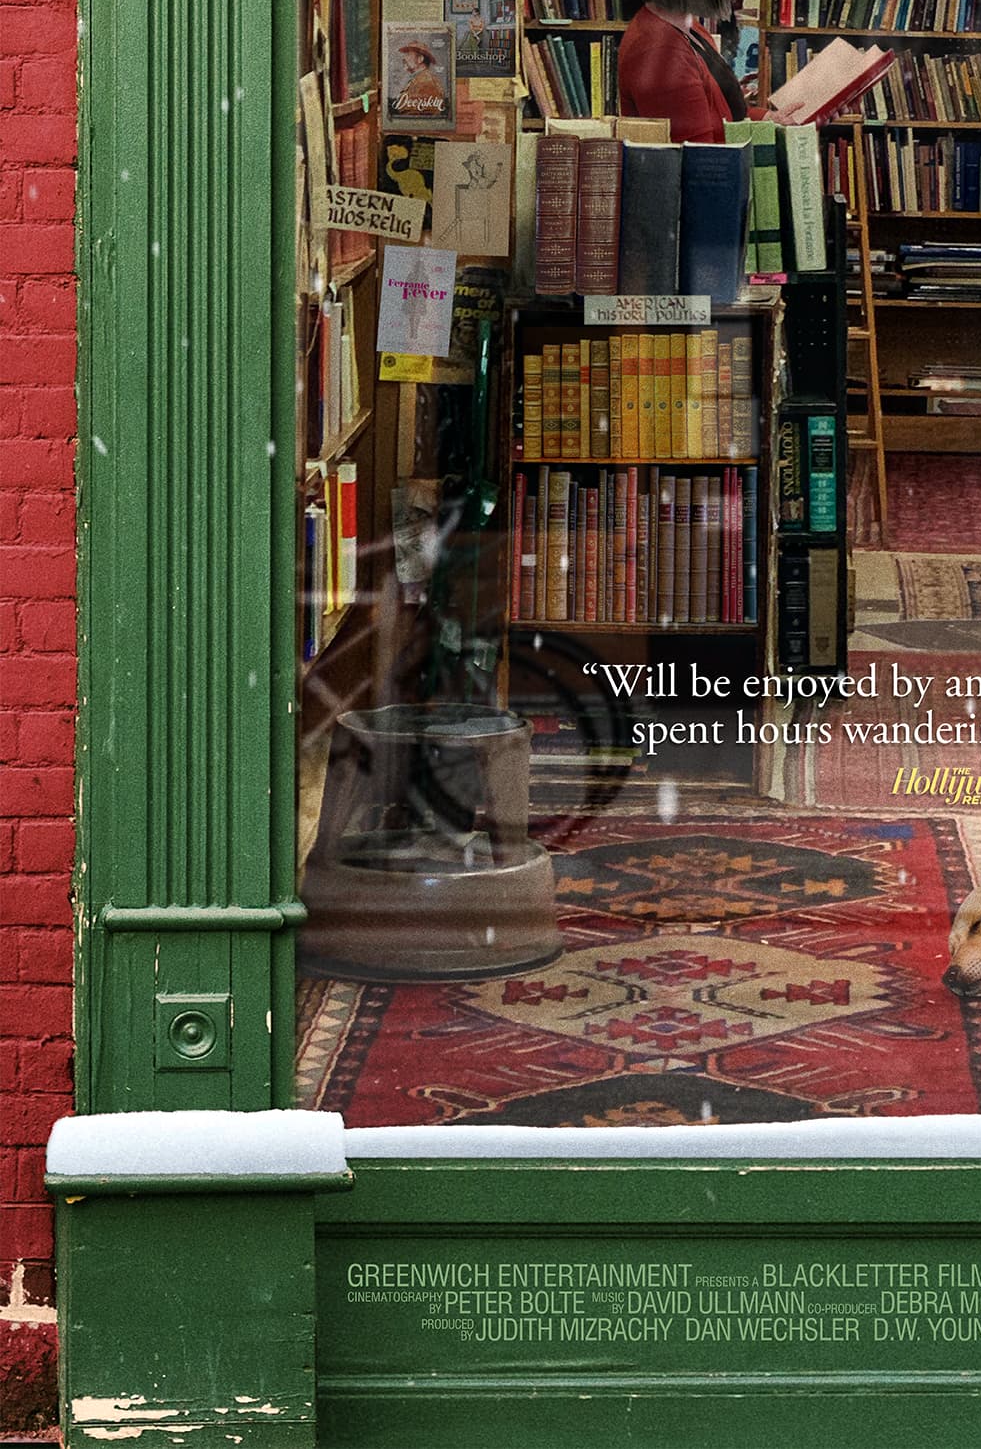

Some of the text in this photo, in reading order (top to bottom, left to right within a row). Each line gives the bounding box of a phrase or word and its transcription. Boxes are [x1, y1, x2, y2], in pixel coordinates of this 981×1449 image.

[388, 278, 430, 290] Ferrante
[402, 288, 447, 300] Fever
[615, 297, 686, 310] AMERICAN
